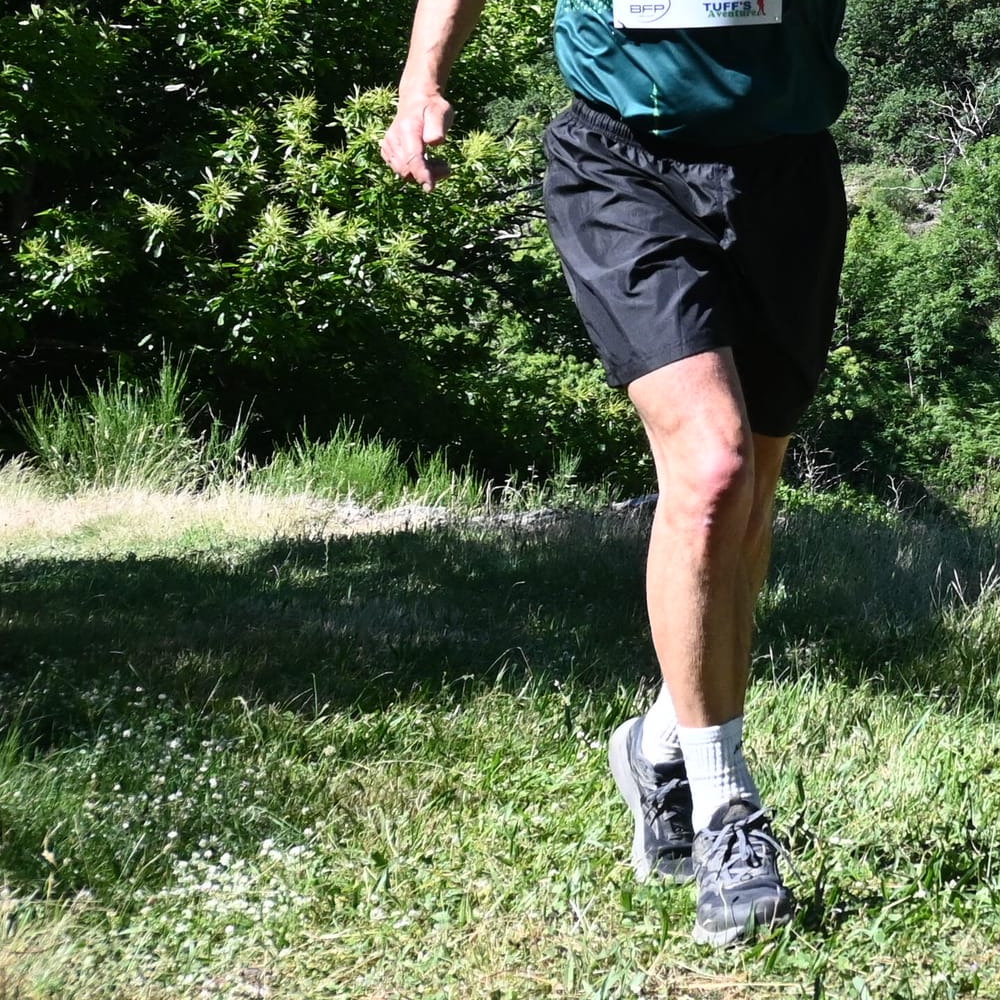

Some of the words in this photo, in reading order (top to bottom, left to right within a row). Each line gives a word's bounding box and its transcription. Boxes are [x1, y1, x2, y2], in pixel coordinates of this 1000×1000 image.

[630, 4, 665, 14] BFP
[702, 1, 752, 12] TUFF'S
[707, 9, 757, 18] Aventure
